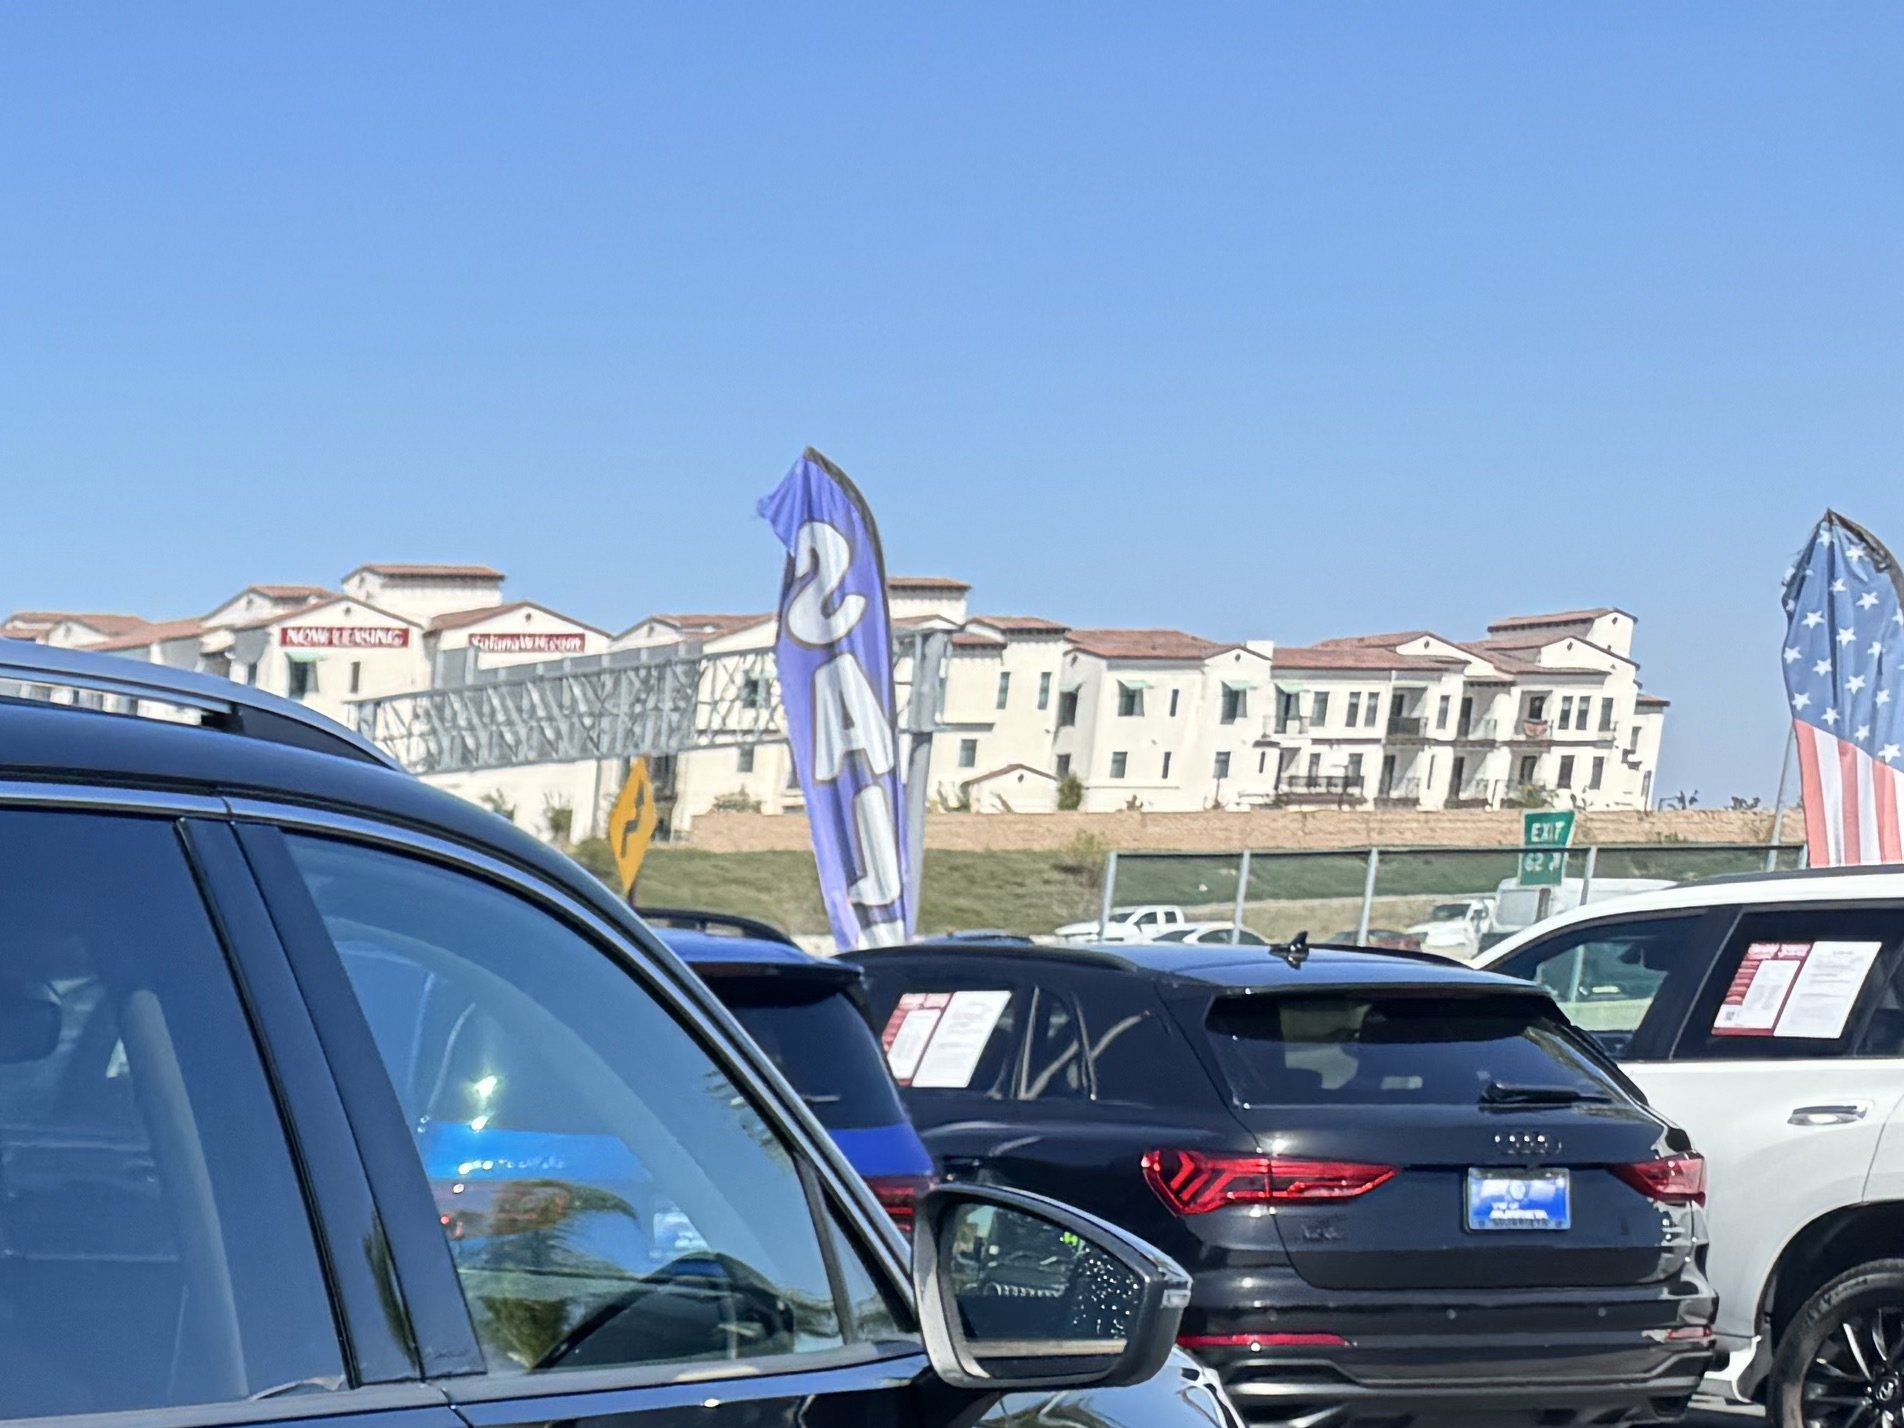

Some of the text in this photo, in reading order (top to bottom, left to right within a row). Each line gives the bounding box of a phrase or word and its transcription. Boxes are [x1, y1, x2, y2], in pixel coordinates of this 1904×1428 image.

[286, 628, 404, 646] NOW LEASING
[1531, 821, 1566, 842] EXIT
